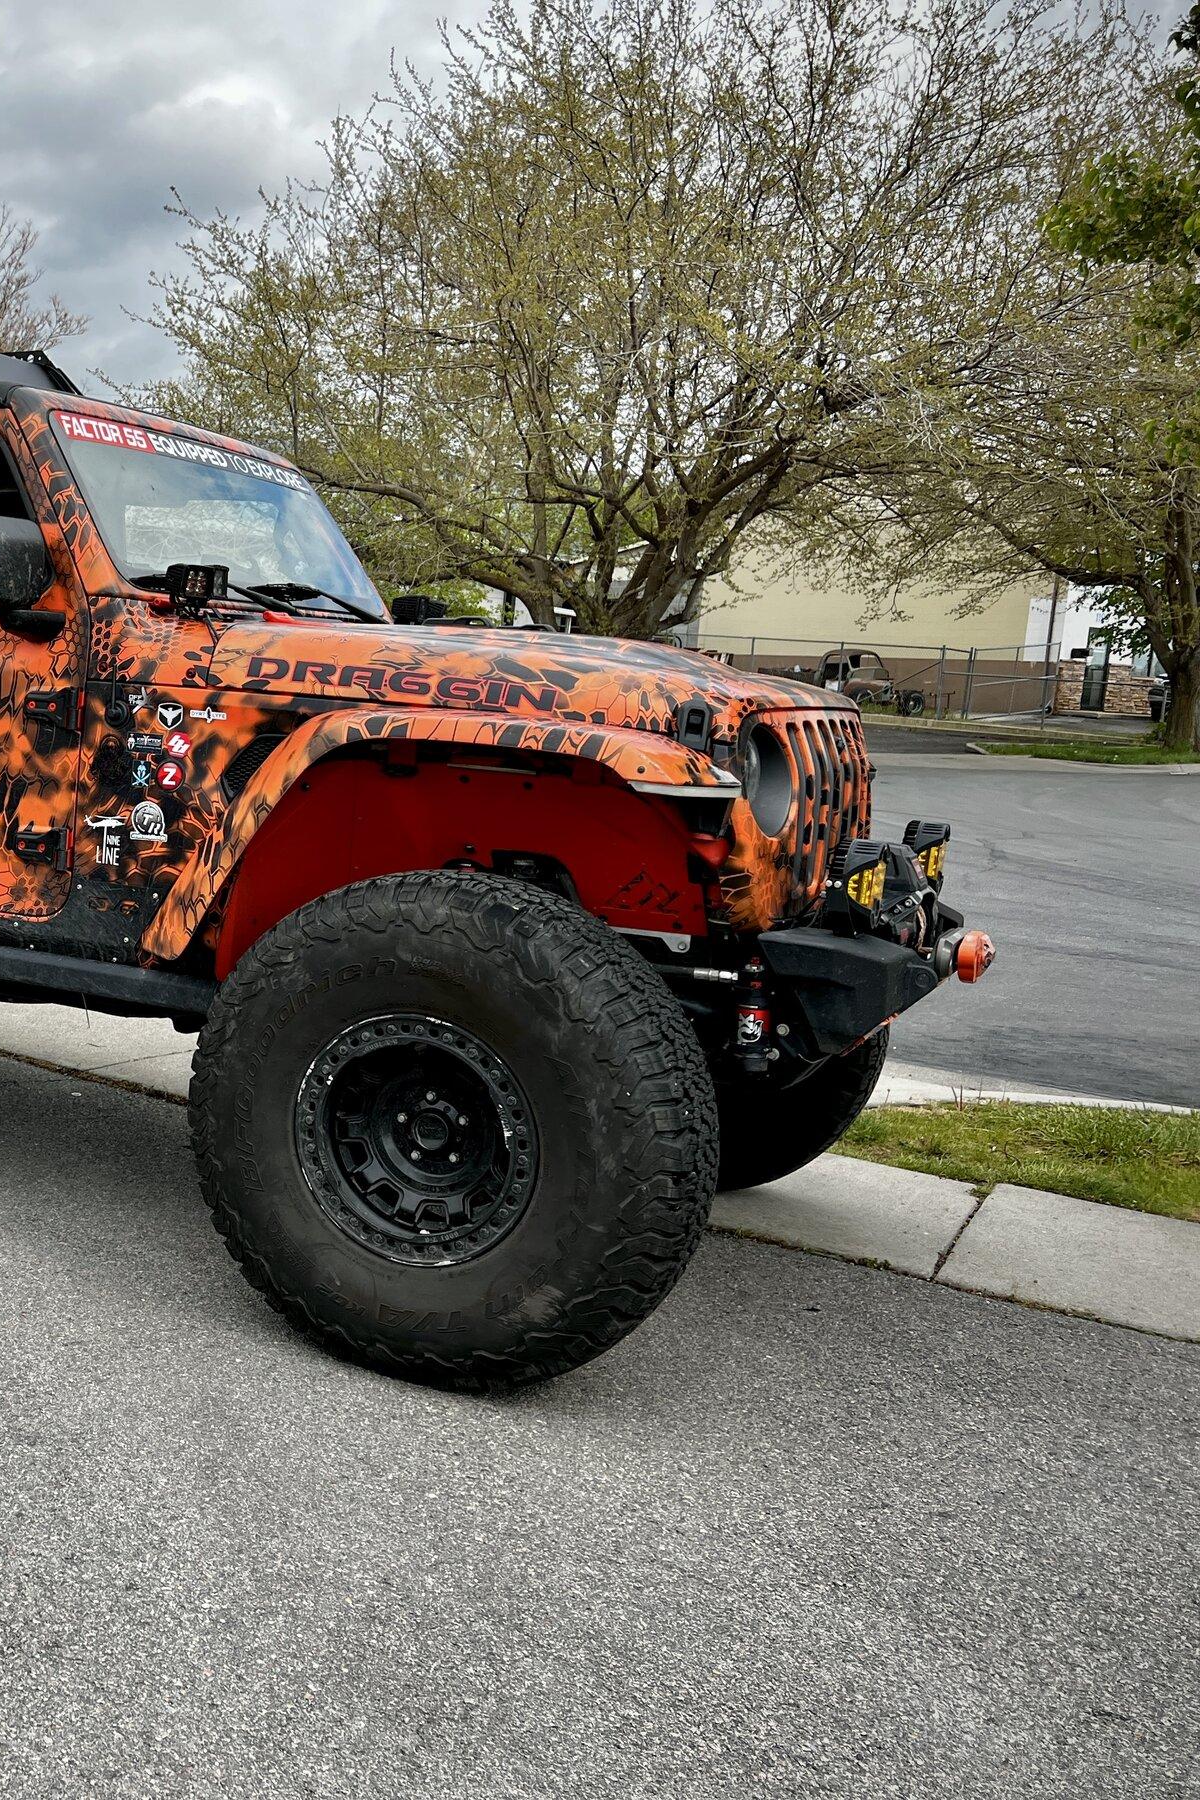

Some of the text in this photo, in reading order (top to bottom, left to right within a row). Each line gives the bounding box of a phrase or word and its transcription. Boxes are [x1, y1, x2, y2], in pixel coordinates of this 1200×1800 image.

[60, 415, 309, 492] FACTOR 55 EQUIPPED TO EXPLORE
[246, 656, 557, 713] DRAGGIN
[162, 767, 177, 786] Z
[106, 834, 121, 847] NINE
[95, 845, 121, 867] LINE
